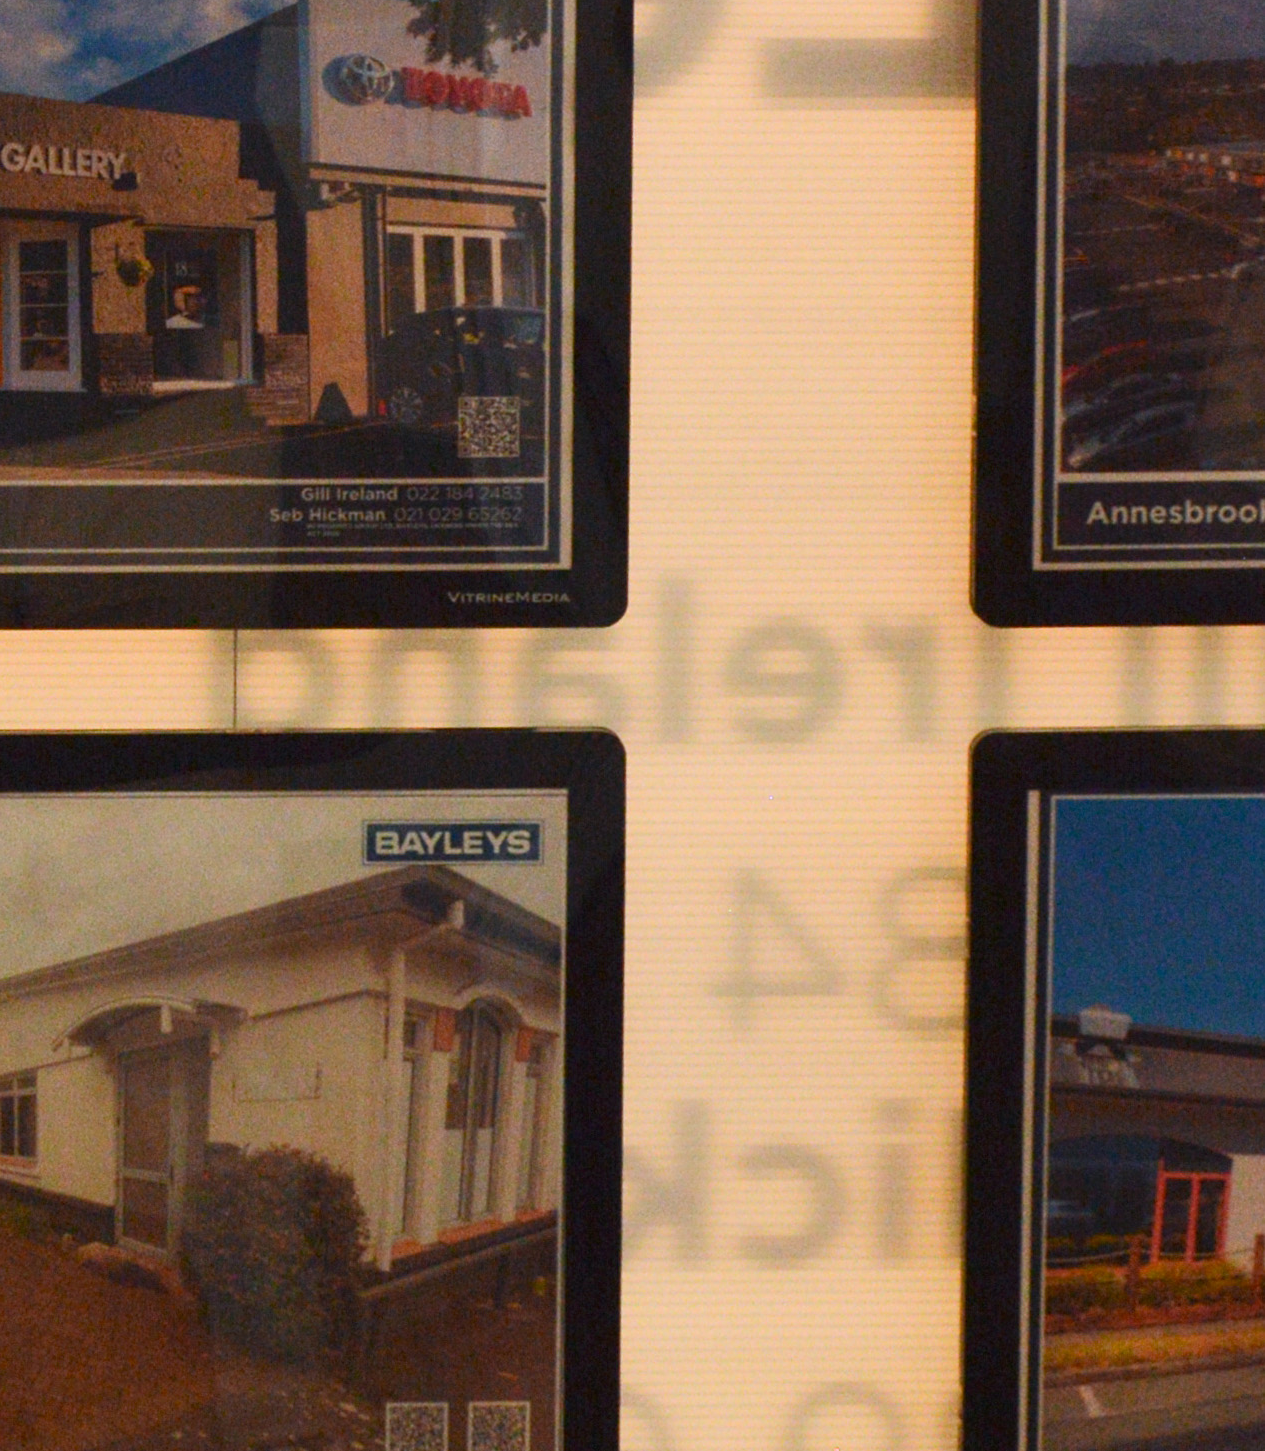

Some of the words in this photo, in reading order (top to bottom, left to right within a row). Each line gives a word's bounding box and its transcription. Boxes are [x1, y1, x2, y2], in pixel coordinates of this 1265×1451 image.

[402, 66, 533, 117] TOYOTA
[0, 143, 127, 180] GALLERY
[301, 487, 331, 502] Gill
[337, 487, 398, 502] Ireland
[407, 486, 439, 501] 022
[446, 486, 473, 500] 184
[480, 486, 523, 500] 2483
[270, 507, 303, 522] Seb
[309, 507, 386, 522] Hickman
[394, 507, 423, 522] 021
[429, 507, 463, 522] 029
[468, 507, 523, 522] 65262
[1086, 499, 1265, 525] Annesbroo
[375, 830, 532, 855] BAYLEYS
